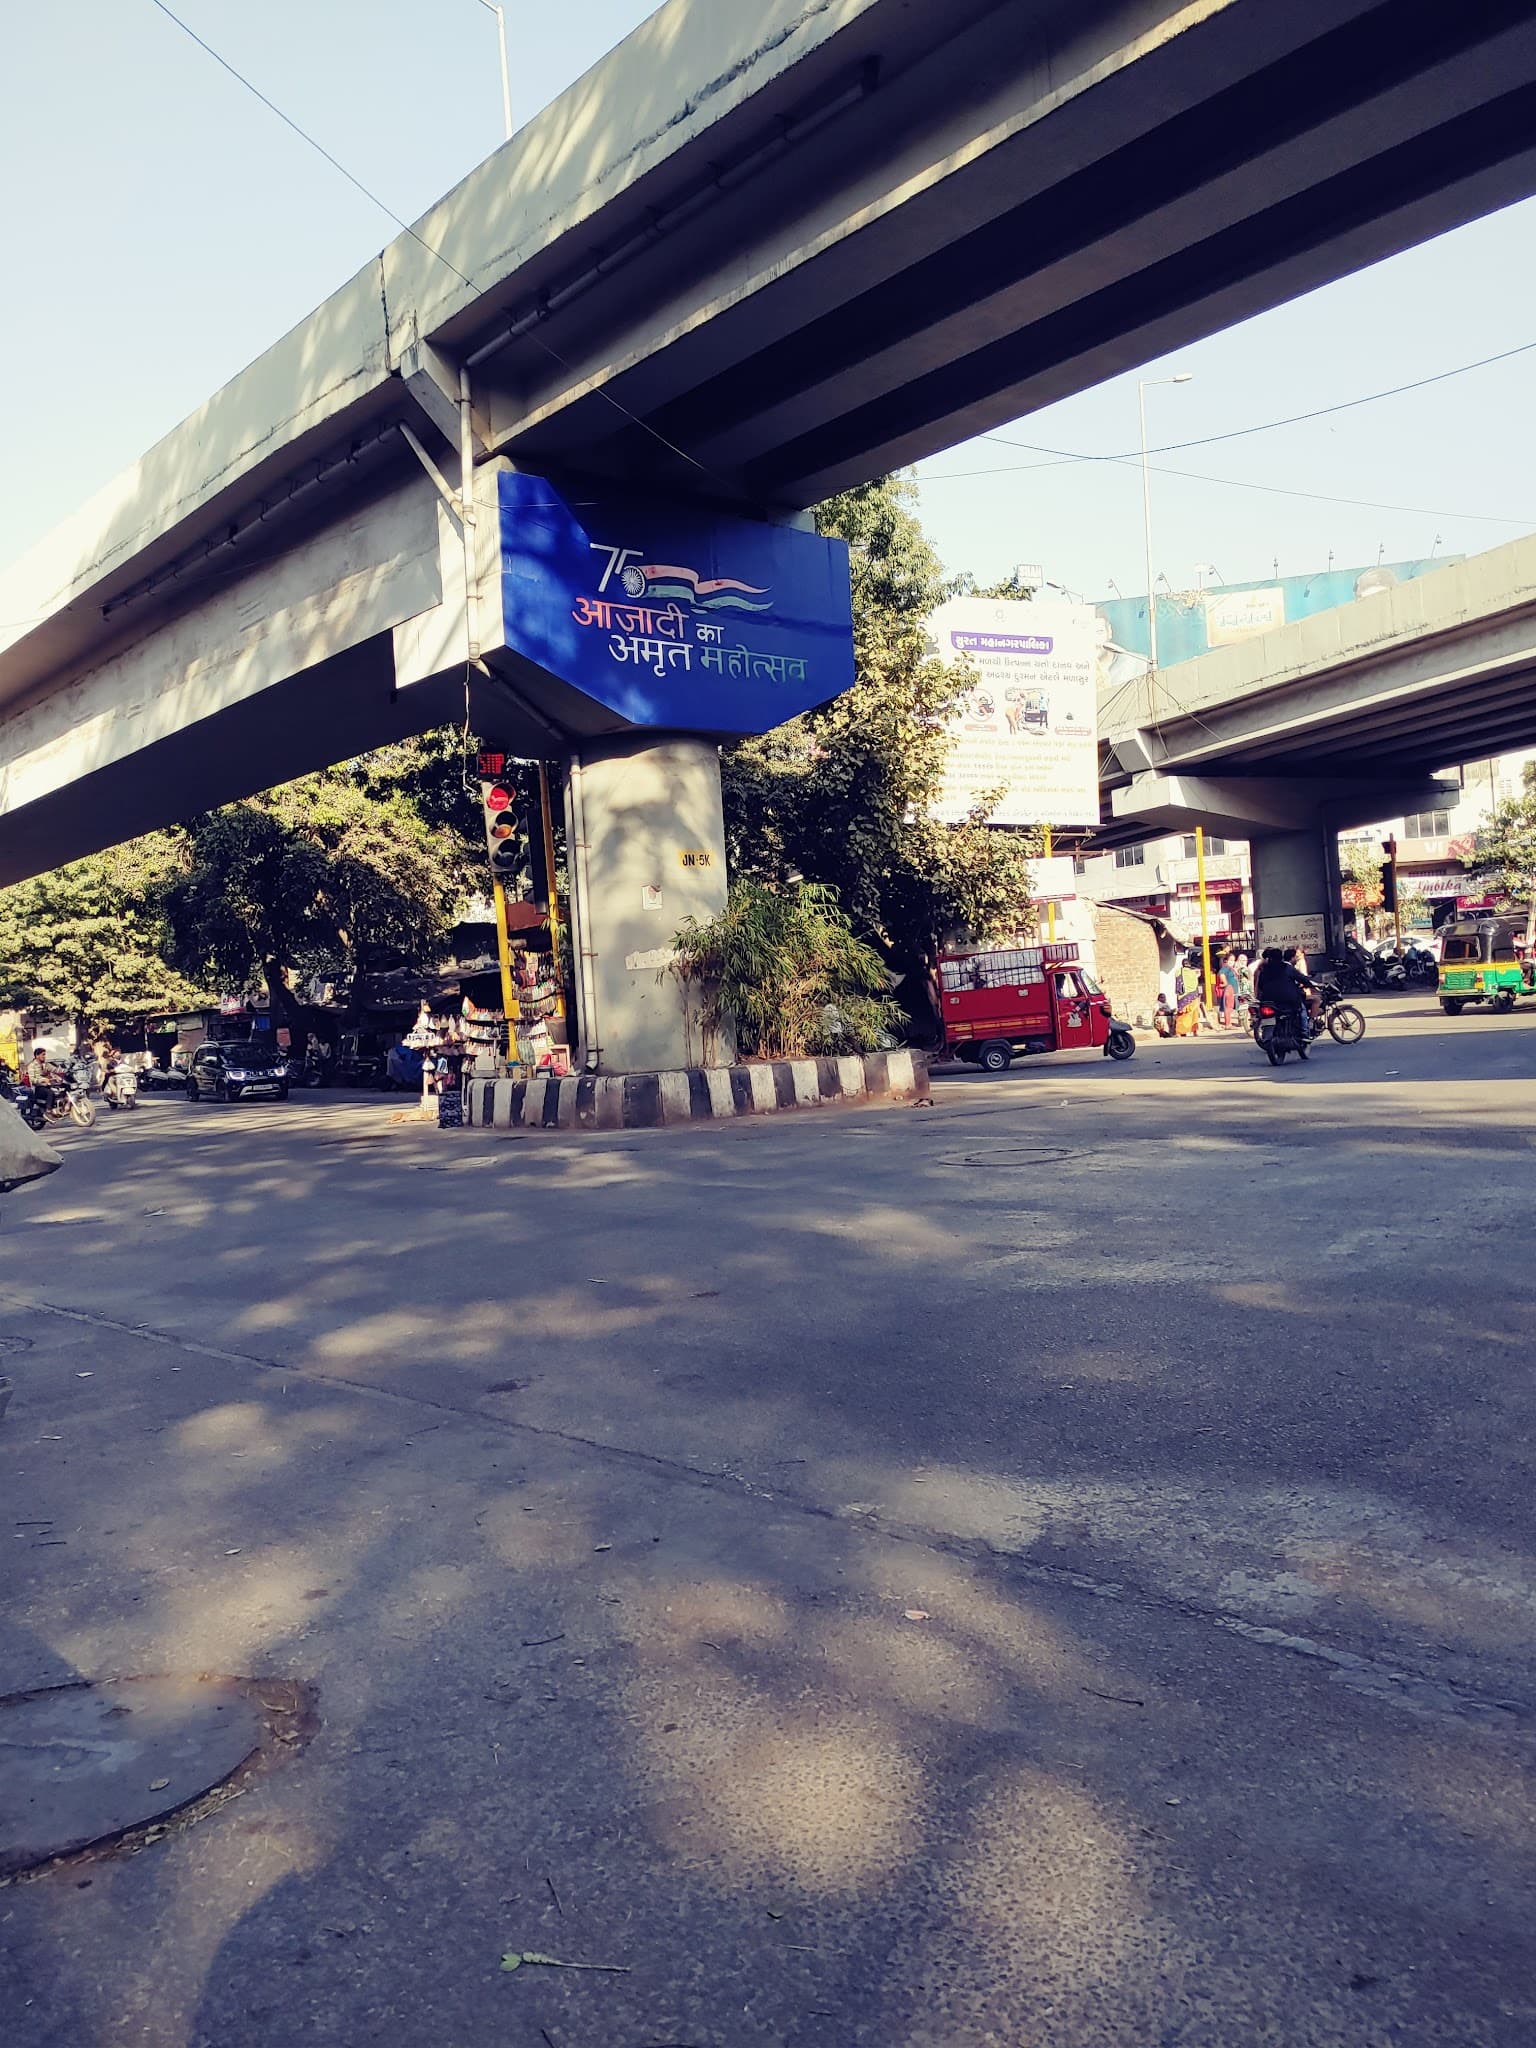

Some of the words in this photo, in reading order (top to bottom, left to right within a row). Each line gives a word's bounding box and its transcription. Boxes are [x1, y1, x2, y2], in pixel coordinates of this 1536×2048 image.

[571, 596, 690, 639] आज़ादी
[696, 622, 724, 645] का
[955, 636, 978, 649] સુરત
[980, 636, 1050, 651] મહાનગરપાલિકા
[608, 633, 693, 677] अमृत
[700, 643, 809, 684] महोत्सव
